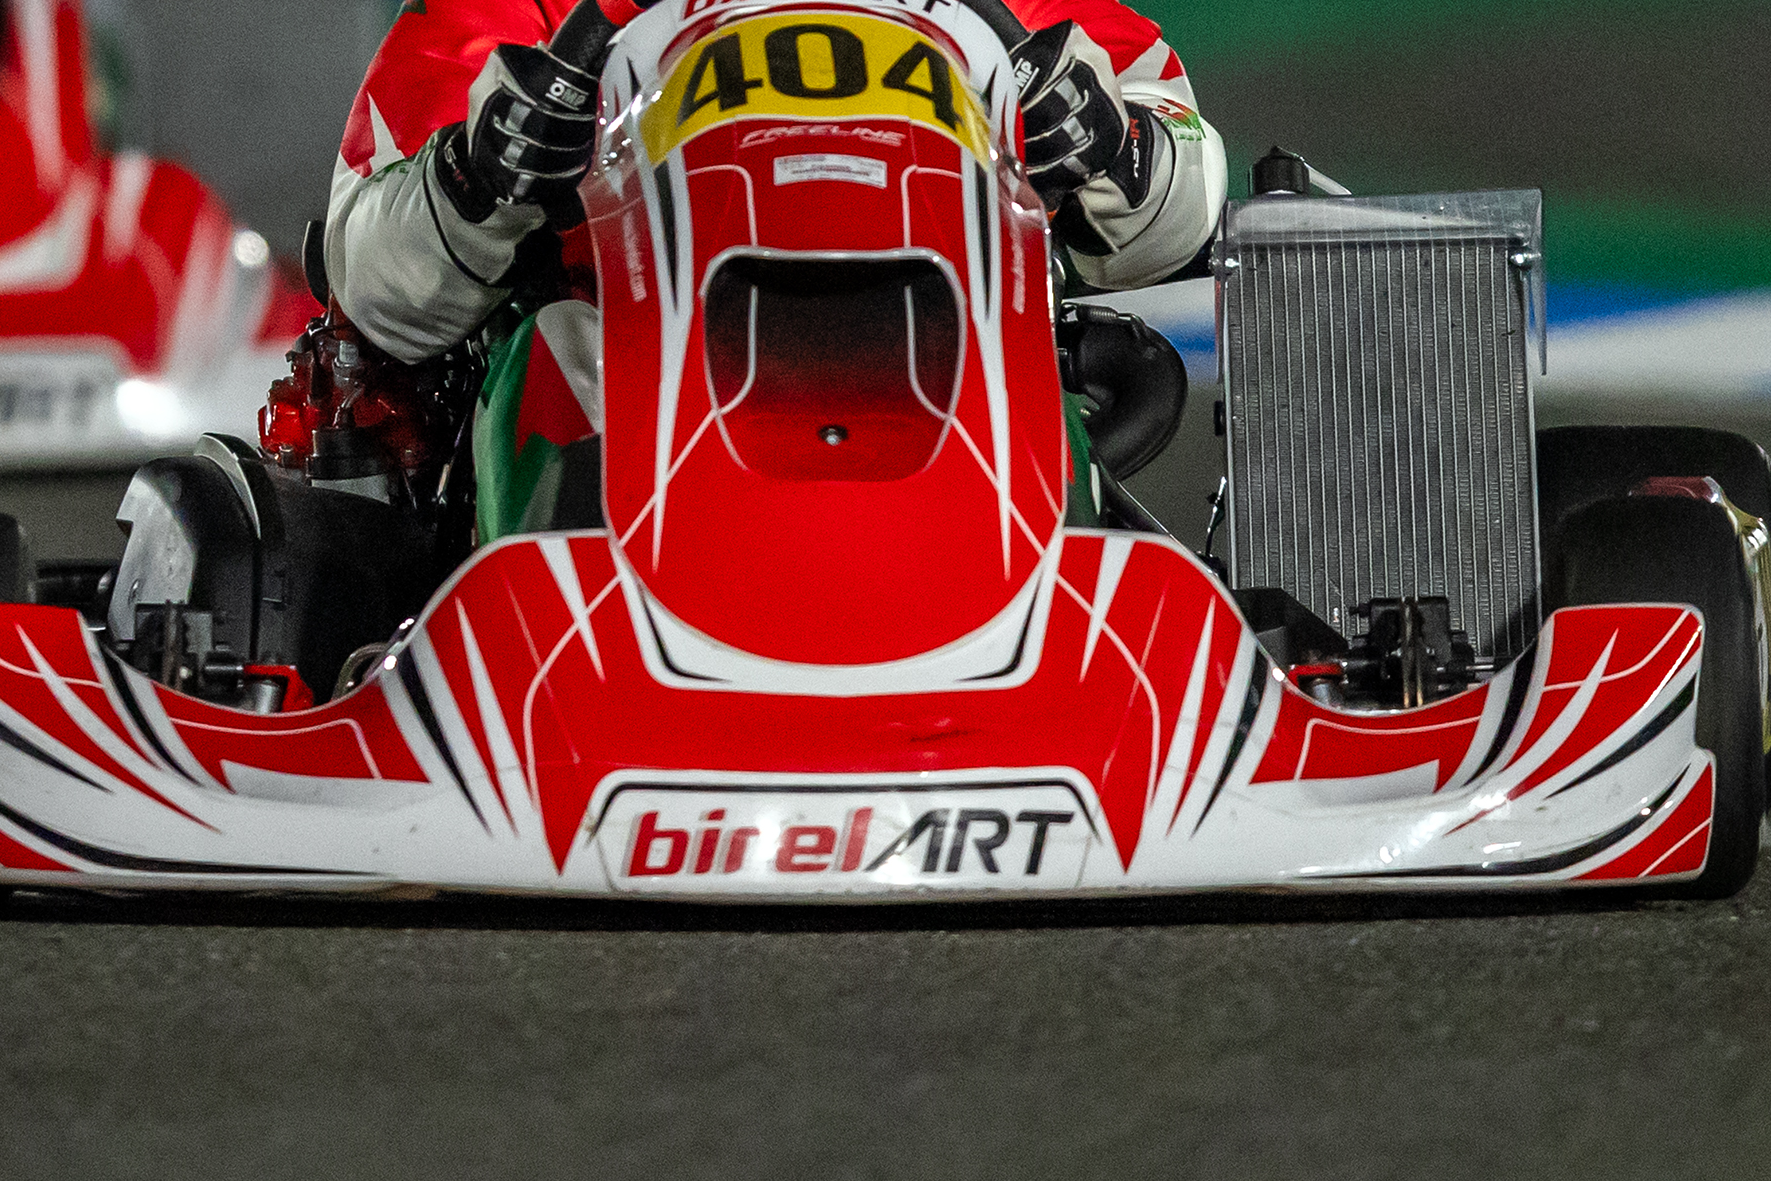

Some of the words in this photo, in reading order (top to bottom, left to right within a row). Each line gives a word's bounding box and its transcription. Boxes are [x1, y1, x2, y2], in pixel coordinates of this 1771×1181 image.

[549, 82, 587, 107] OMP
[676, 22, 964, 133] 404
[625, 806, 1075, 878] birelART
